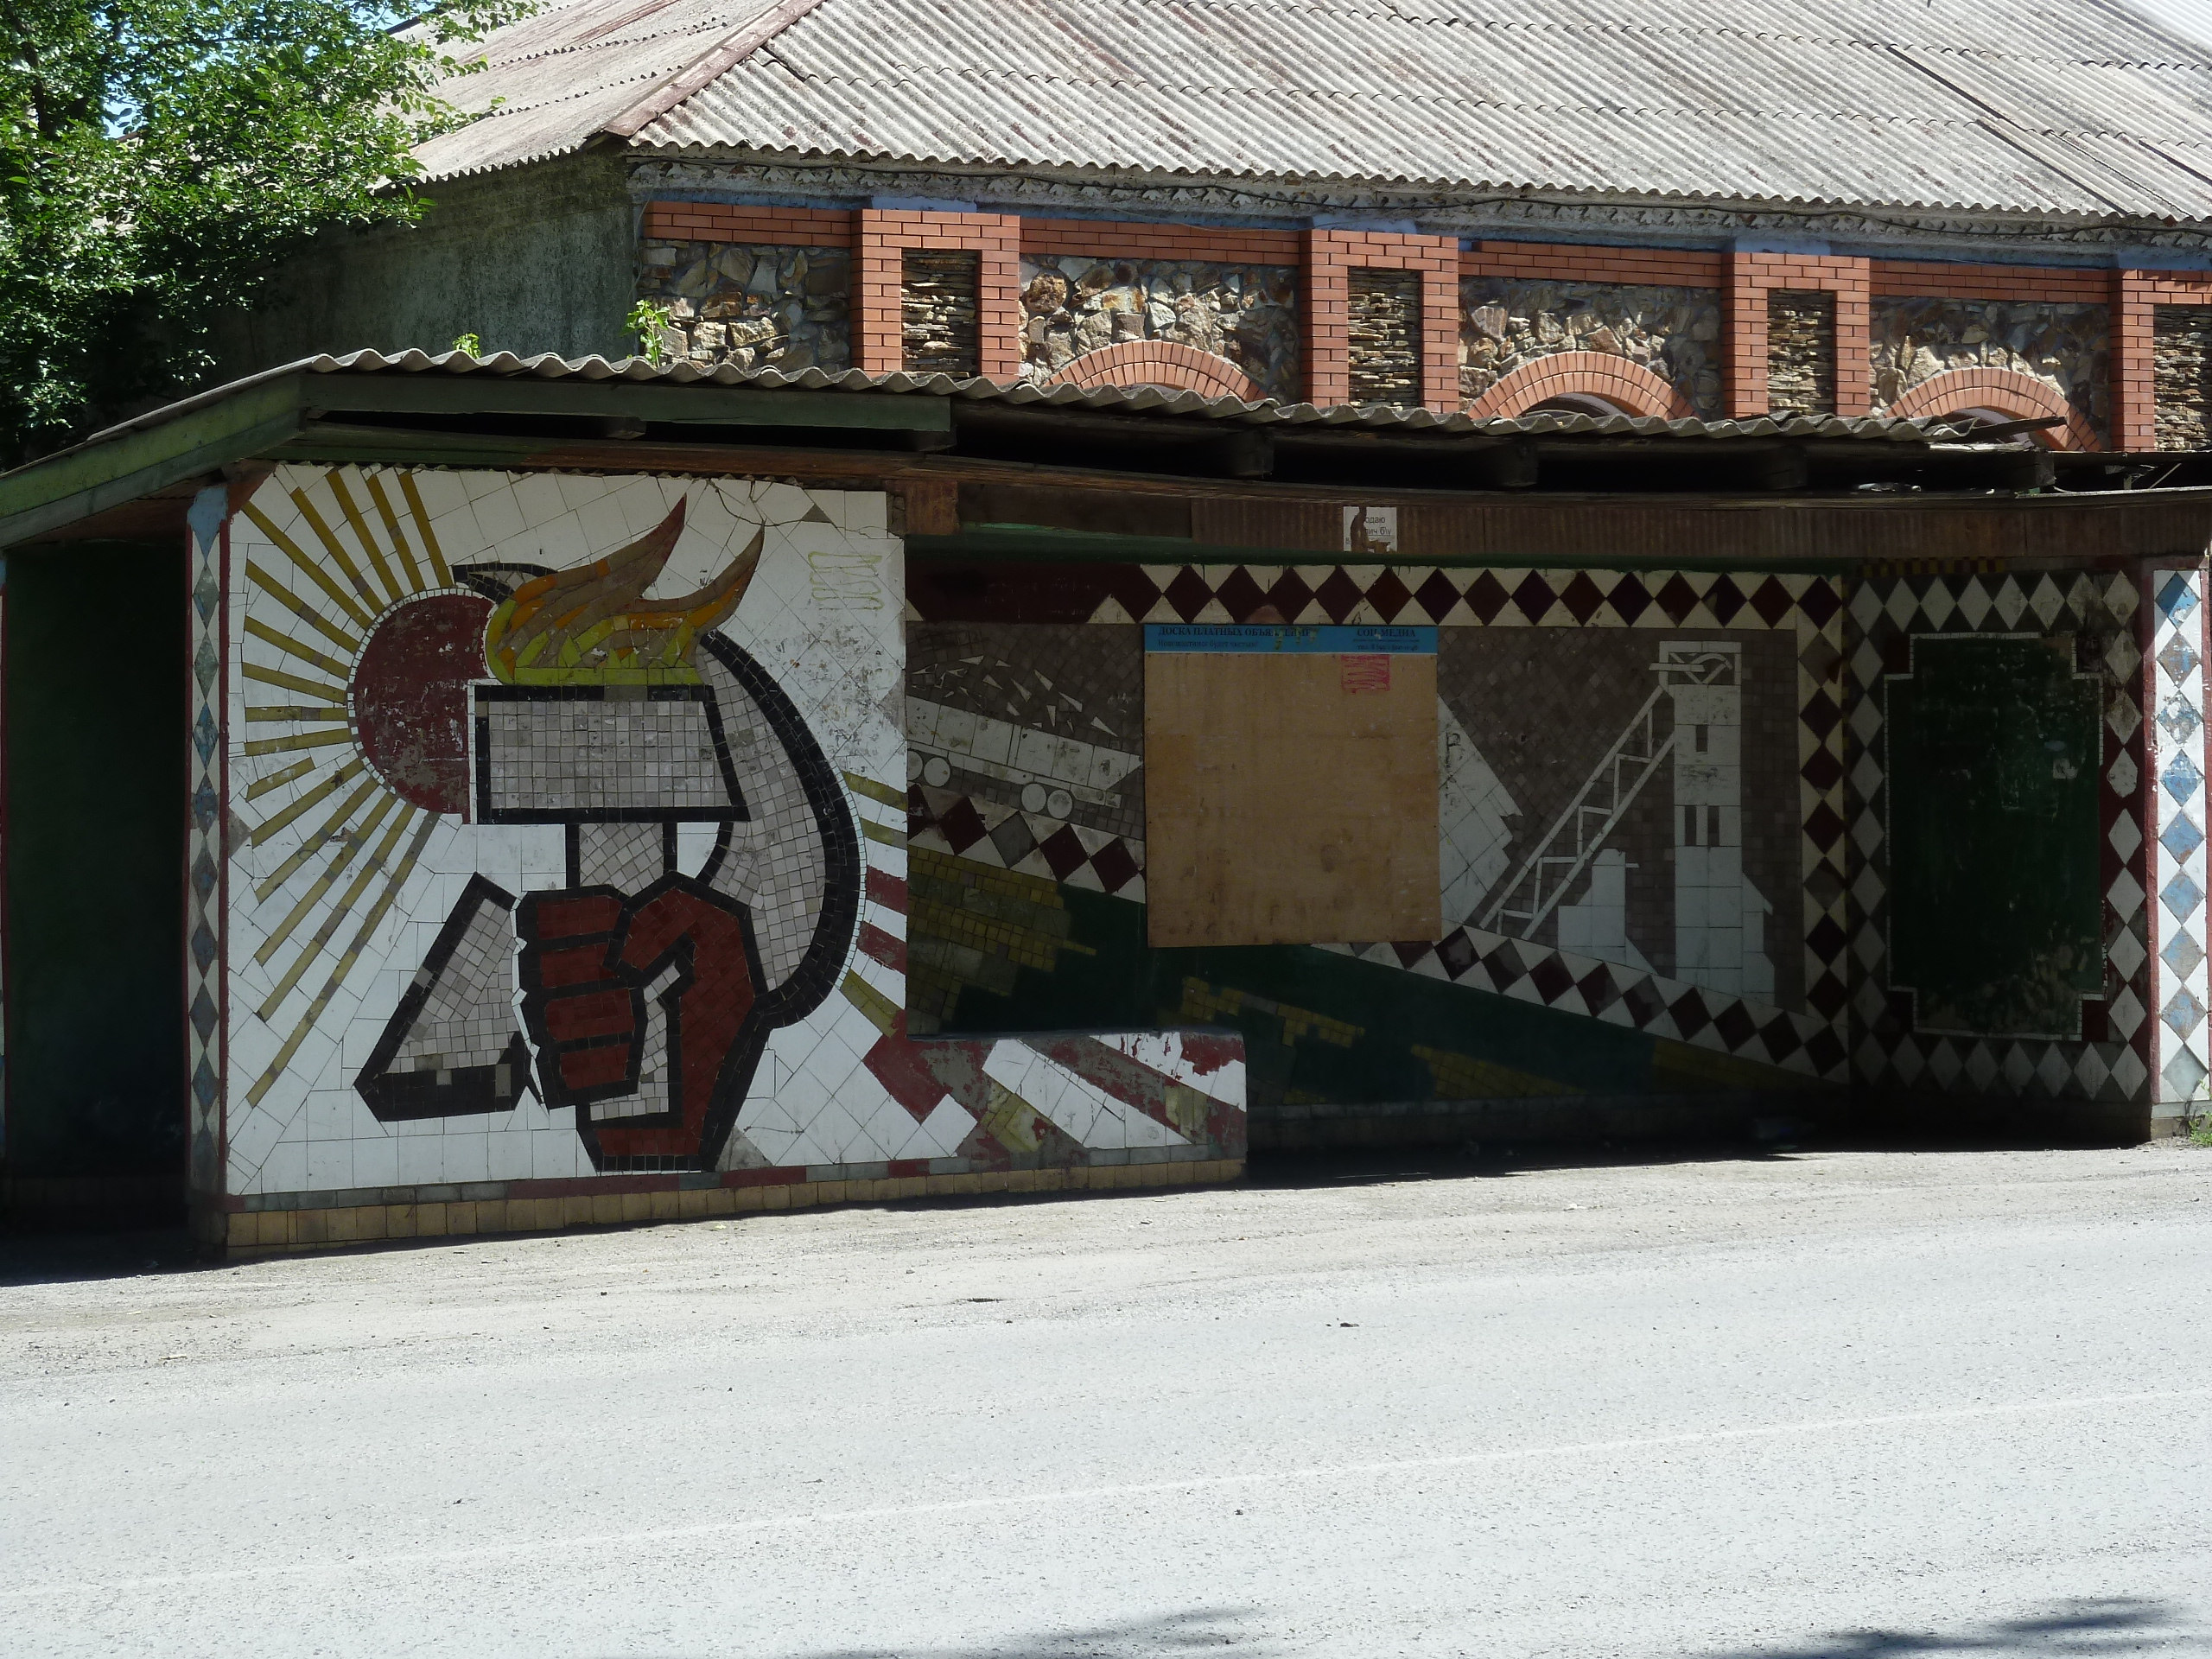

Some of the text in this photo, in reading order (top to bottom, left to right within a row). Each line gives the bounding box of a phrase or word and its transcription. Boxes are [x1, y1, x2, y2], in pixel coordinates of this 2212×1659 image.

[1158, 626, 1313, 638] ДОСКА ПЛАТНЫХ ОБЪЯЕНИЙ
